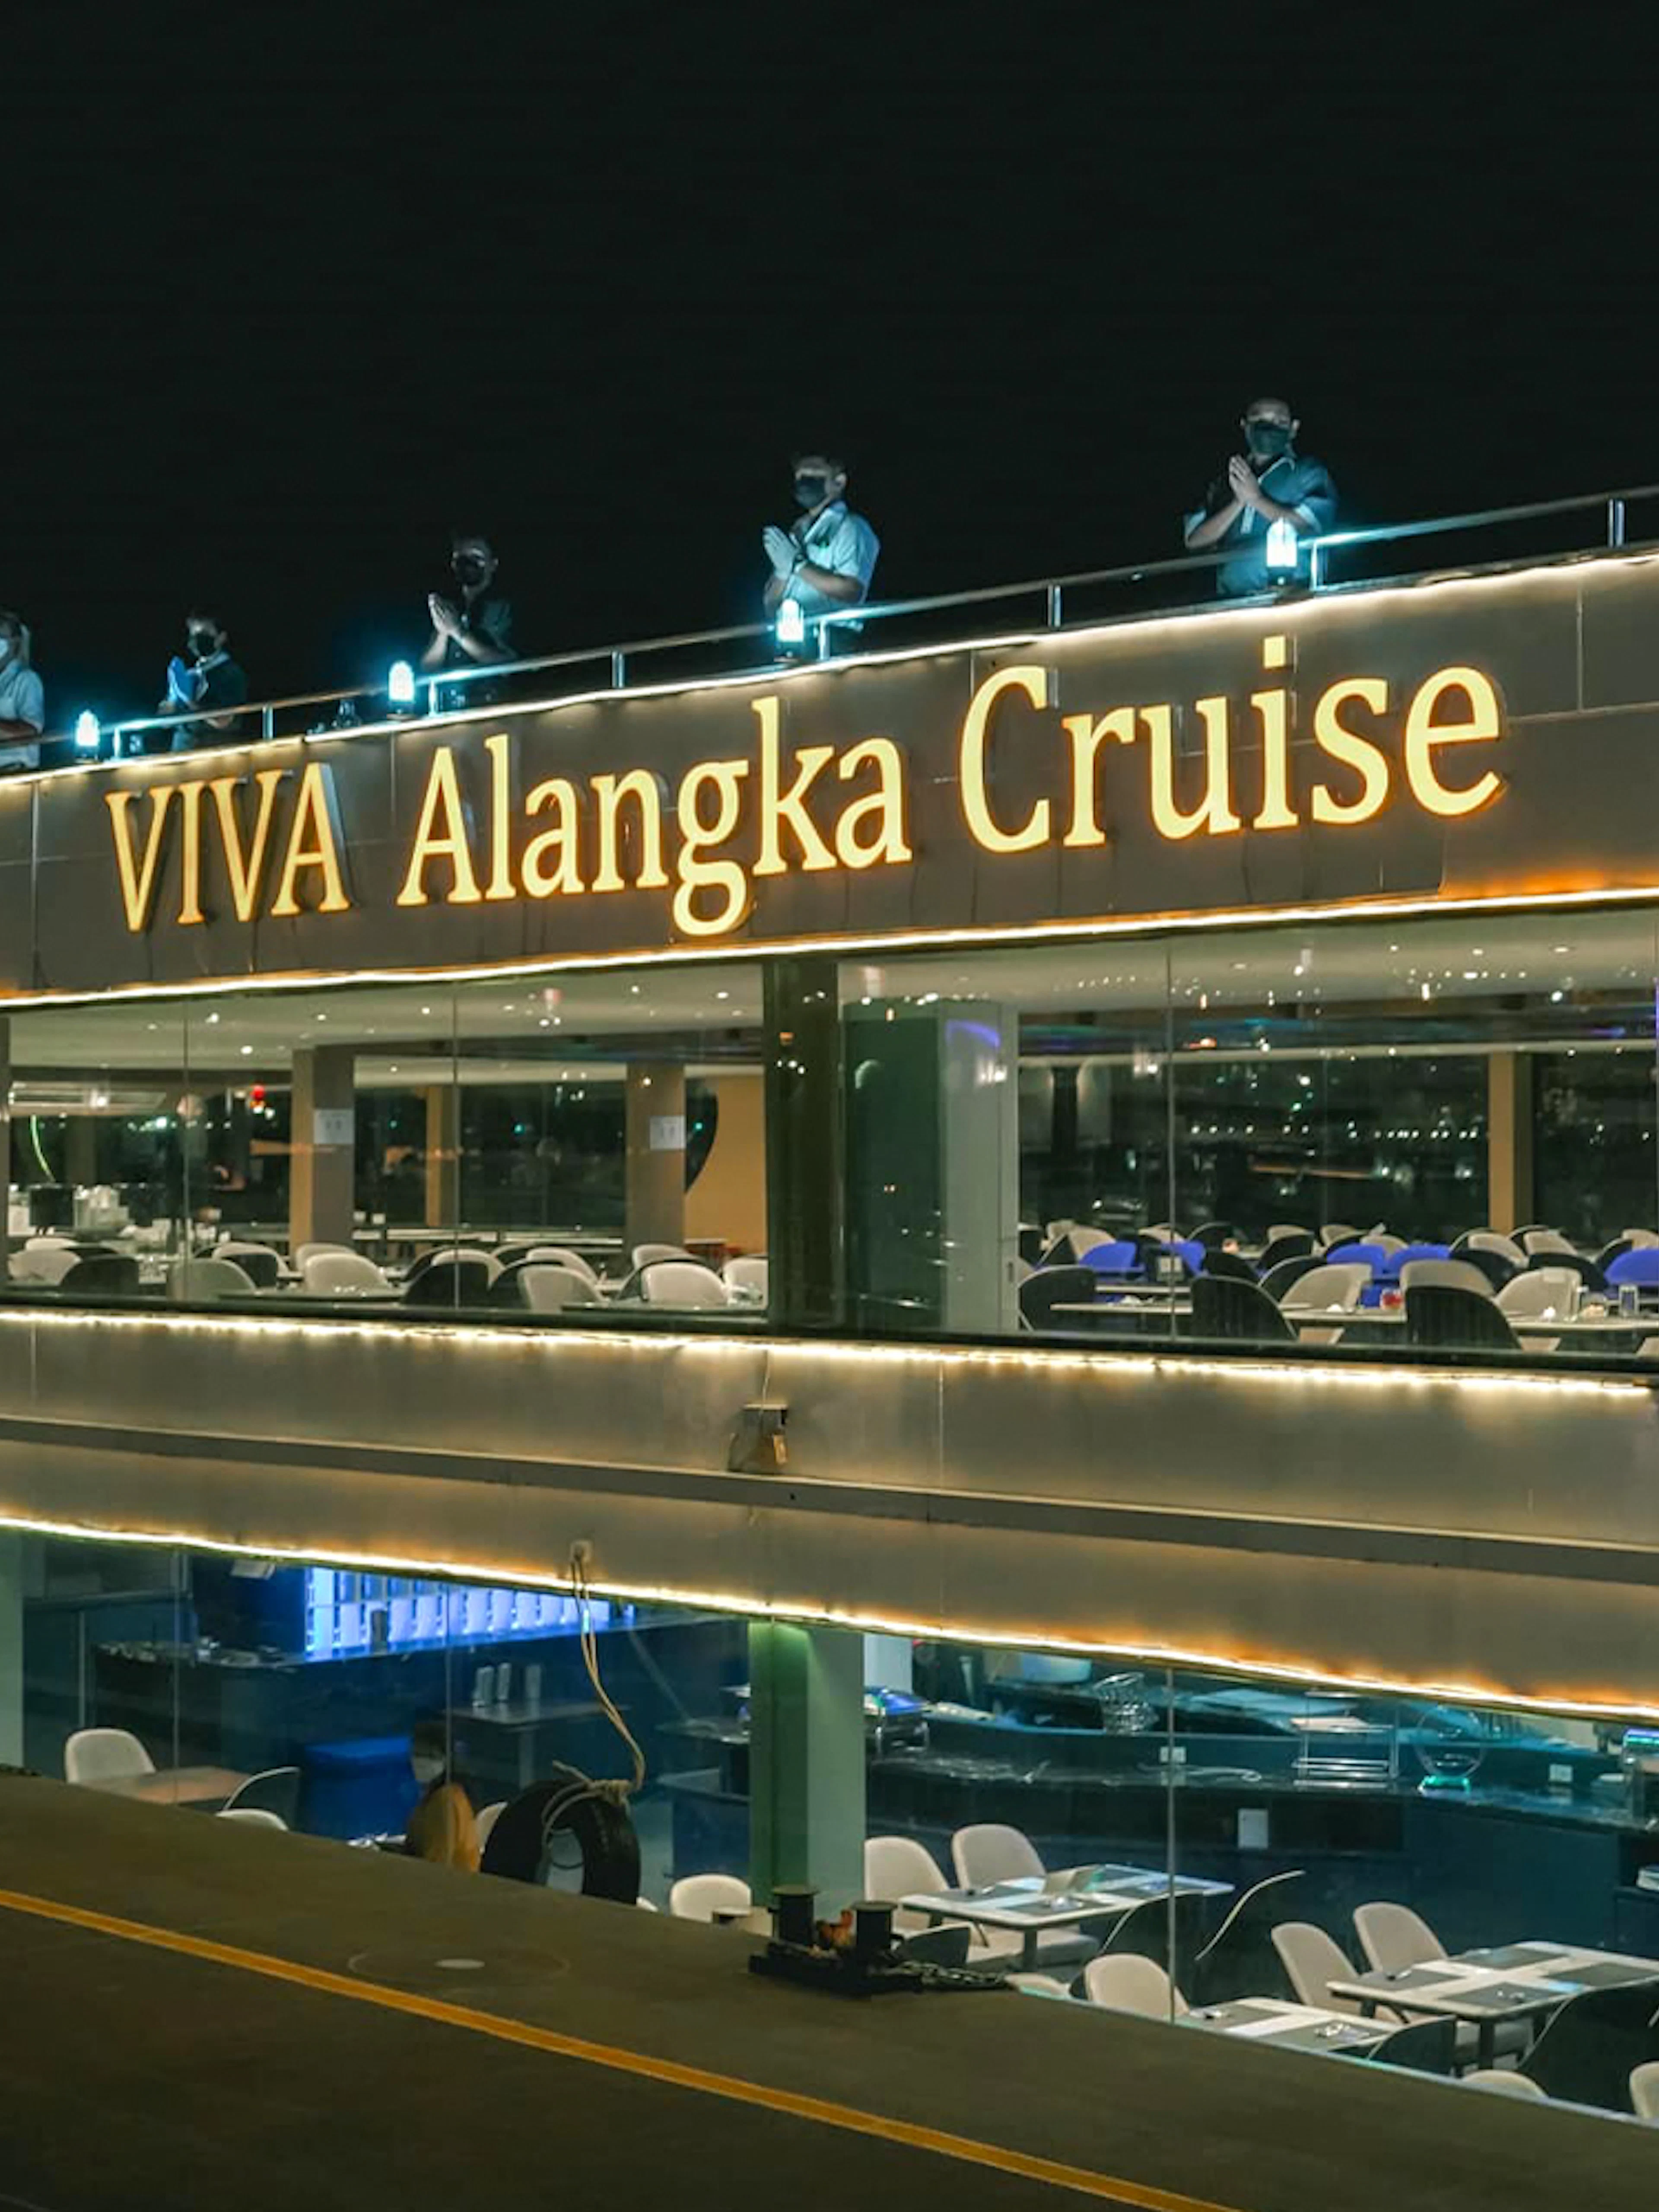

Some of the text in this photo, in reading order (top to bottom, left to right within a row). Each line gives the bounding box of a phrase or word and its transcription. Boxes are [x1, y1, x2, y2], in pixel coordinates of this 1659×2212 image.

[106, 635, 1501, 938] VIVA Alangka Cruise
